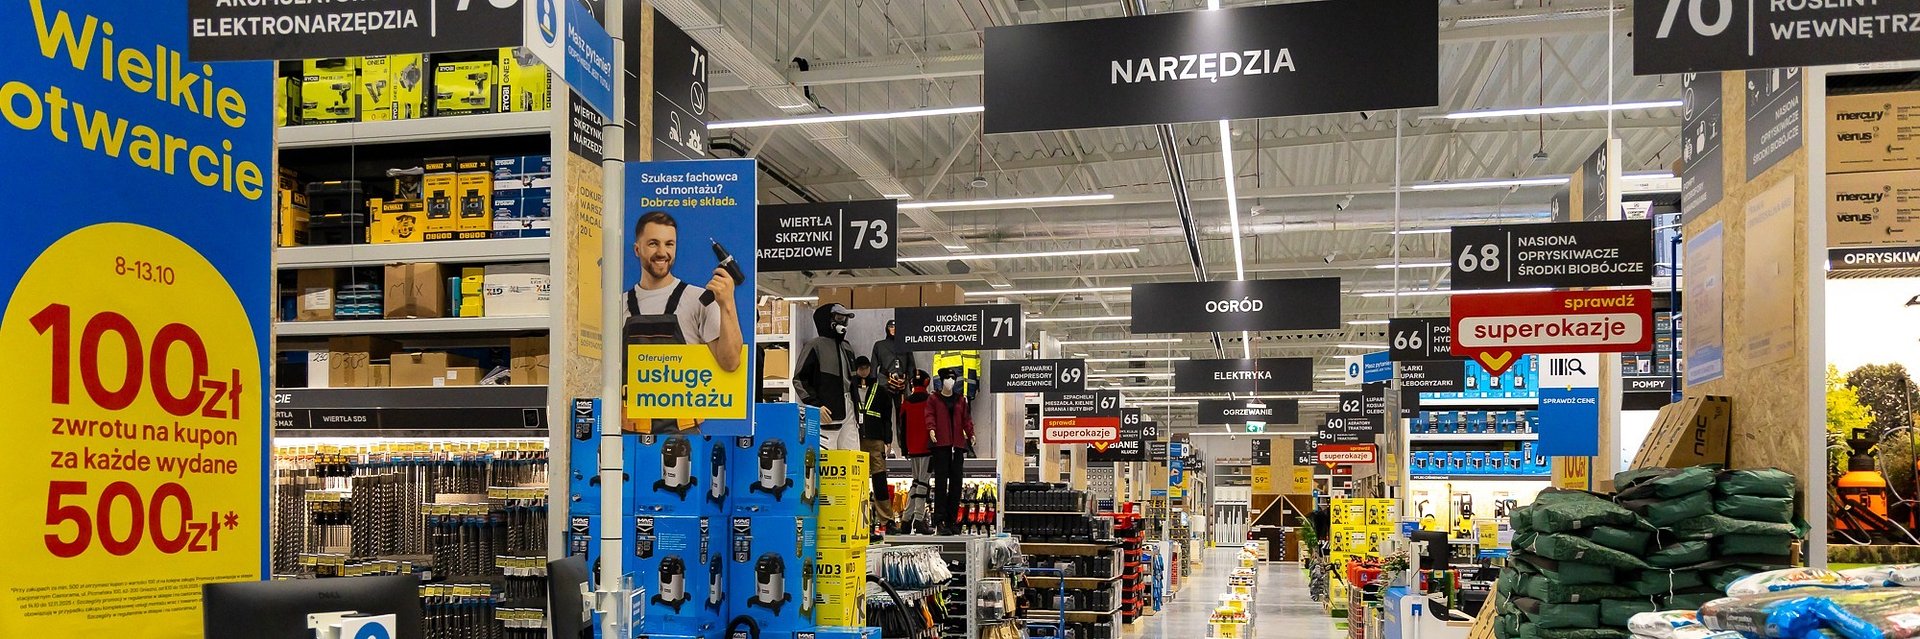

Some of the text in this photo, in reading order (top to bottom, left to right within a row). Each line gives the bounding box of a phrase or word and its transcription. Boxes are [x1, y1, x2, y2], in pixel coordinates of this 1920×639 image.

[193, 9, 418, 37] ELEKTRONARZĘDZIA
[568, 22, 611, 78] Masz pytanie?
[29, 0, 247, 128] Wielkie
[690, 45, 705, 83] 71
[1111, 48, 1296, 84] NARZĘDZIA
[502, 86, 511, 112] RYOBI
[1775, 96, 1799, 120] NASIONA
[1836, 110, 1884, 121] mercury
[1760, 110, 1799, 145] OPRYSKIWACZE
[0, 81, 263, 200] otwarcie
[1837, 132, 1872, 141] venus
[1596, 148, 1606, 175] 66
[641, 172, 738, 183] Szukasz fachowca
[655, 184, 723, 195] od montażu?
[641, 196, 737, 208] Dobrze się składa.
[1836, 192, 1883, 202] mercury
[780, 216, 832, 228] WIERTŁA
[1837, 213, 1872, 222] venus
[775, 231, 832, 243] SKRZYNKI
[850, 219, 889, 250] 73
[1518, 235, 1577, 247] NASIONA
[1458, 243, 1500, 273] 68
[1518, 248, 1619, 261] OPRYSKIWACZE
[115, 256, 175, 286] 8-13.10
[1518, 261, 1644, 276] ŚRODKI BIOBÓJCZE
[1205, 296, 1263, 313] OGRÓD
[1564, 294, 1635, 311] sprawdź
[936, 313, 977, 322] UKOŚNICE
[923, 324, 977, 333] ODKURZACZE
[990, 317, 1013, 337] 71
[1474, 317, 1626, 343] superokazje
[905, 334, 977, 343] PILARKI STOŁOWE
[1394, 330, 1422, 350] 66
[638, 353, 683, 363] Oferujemy
[637, 365, 713, 388] usługę
[1061, 367, 1081, 383] 69
[1214, 370, 1272, 380] ELEKTRYKA
[637, 388, 733, 407] montażu
[1100, 397, 1117, 409] 67
[1223, 408, 1273, 416] OGRZEWANIE
[1342, 400, 1359, 412] 62
[323, 415, 352, 423] WIERTŁA
[1124, 413, 1139, 424] 65
[1327, 418, 1343, 429] 60
[52, 417, 237, 450] zwrotu na kupon
[1052, 428, 1111, 438] superokazje
[1143, 426, 1155, 437] 63
[51, 446, 237, 479] za każde wydane
[819, 466, 846, 476] WD 3
[834, 564, 841, 574] 3
